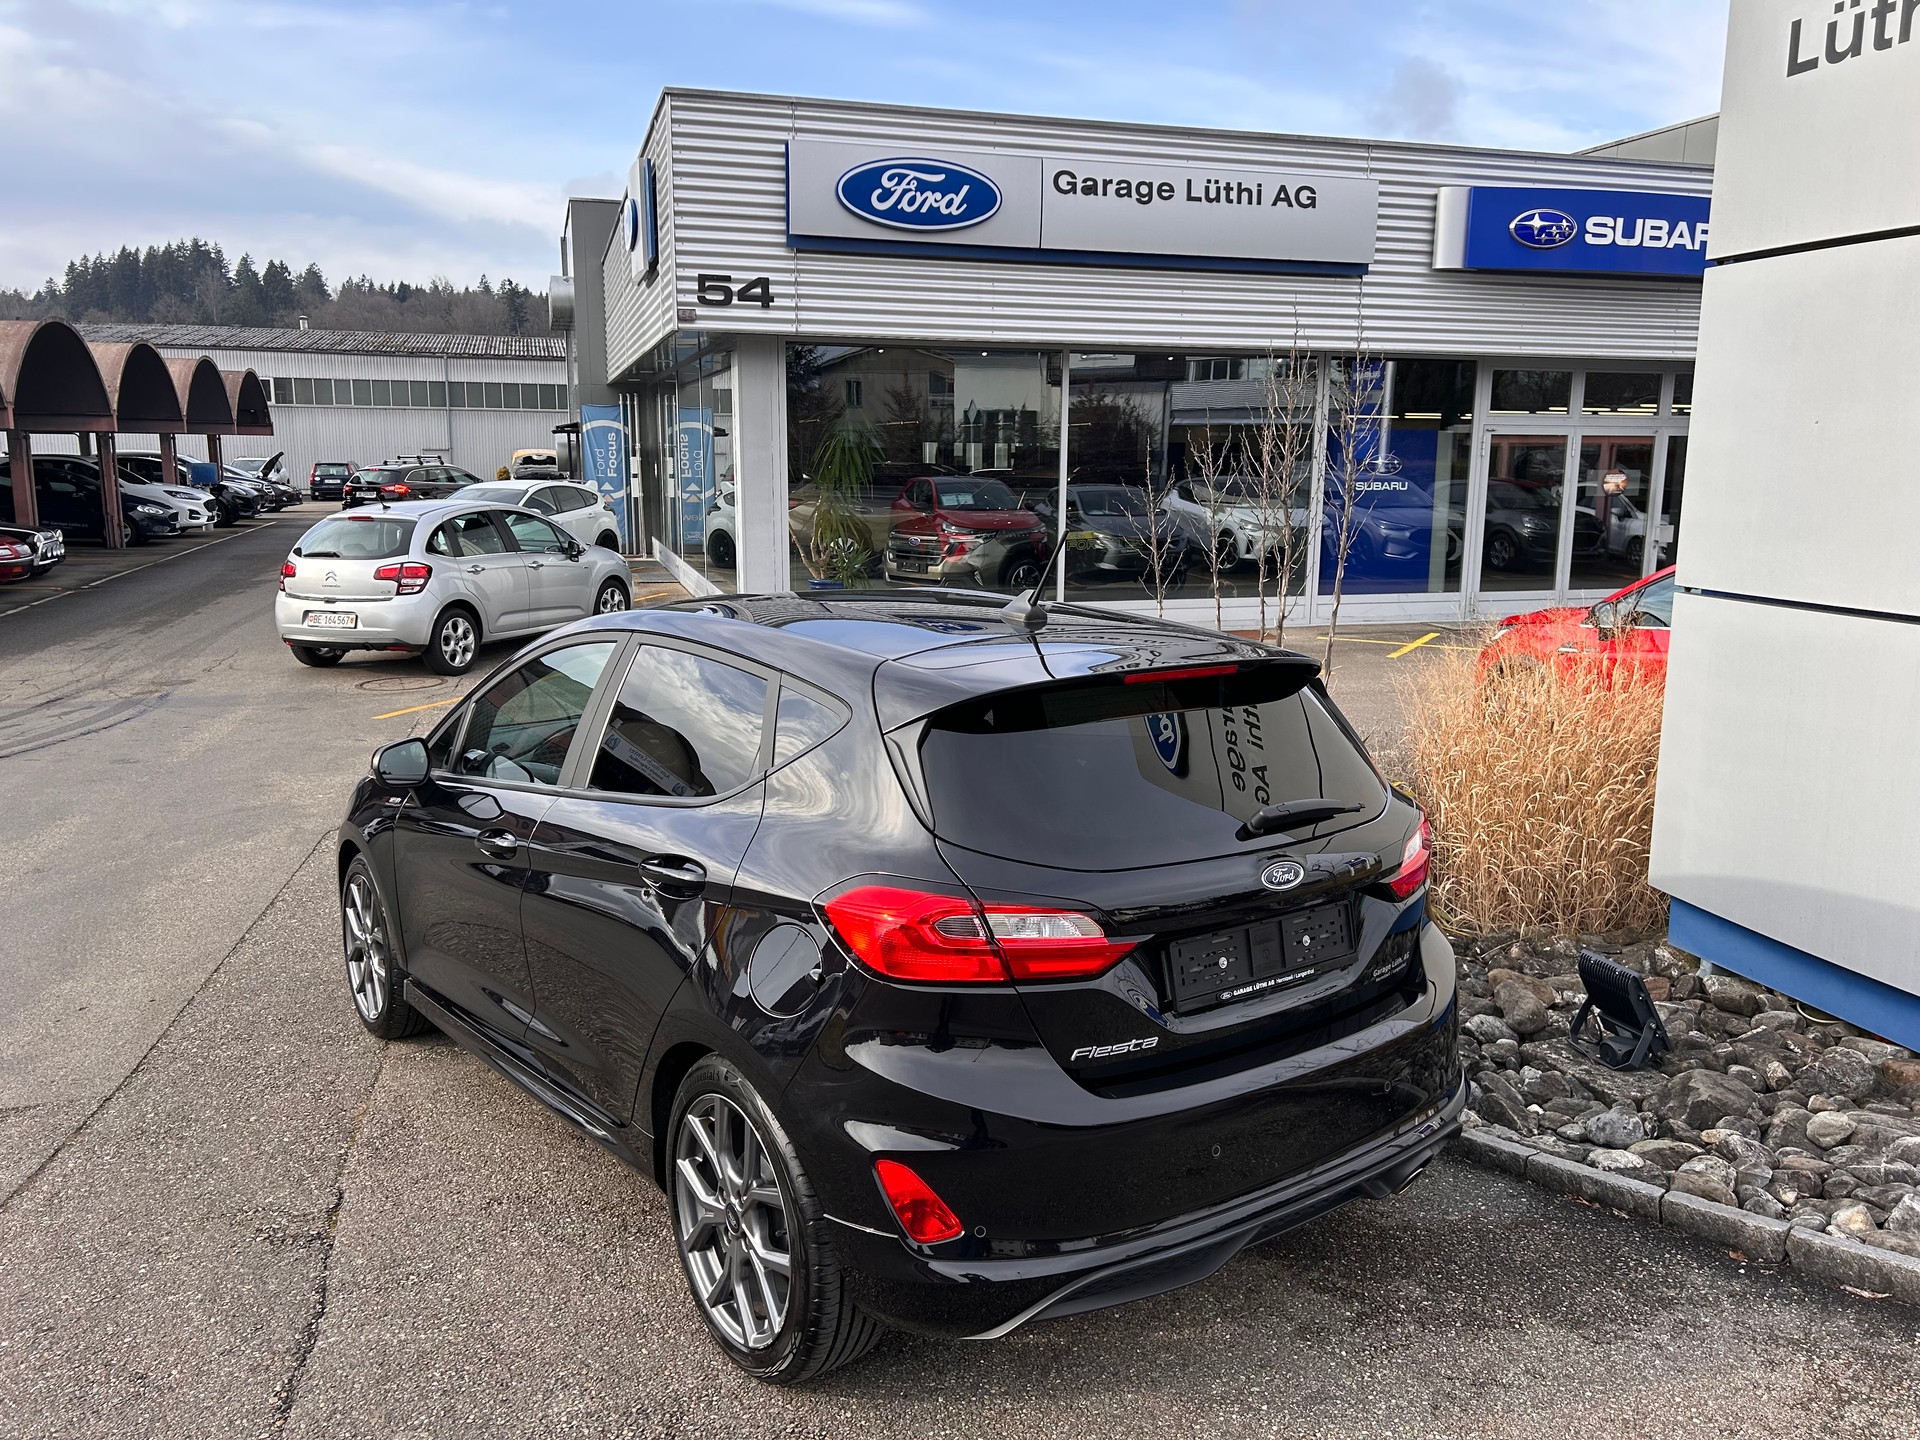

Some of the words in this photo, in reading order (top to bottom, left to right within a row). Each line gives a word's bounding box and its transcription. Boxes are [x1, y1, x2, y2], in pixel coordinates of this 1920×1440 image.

[870, 168, 970, 216] Ford
[1052, 169, 1176, 205] Garage
[1186, 178, 1263, 206] Lüthi
[1271, 184, 1317, 209] AG
[696, 273, 775, 309] 54
[595, 448, 605, 478] Ford
[607, 431, 618, 478] Focus
[1355, 481, 1409, 491] SUBARU
[1272, 867, 1295, 883] Ford
[1373, 963, 1391, 977] Garage
[1233, 985, 1253, 996] GARAGE
[1267, 979, 1275, 987] AG
[1069, 1036, 1159, 1062] Fiesta
